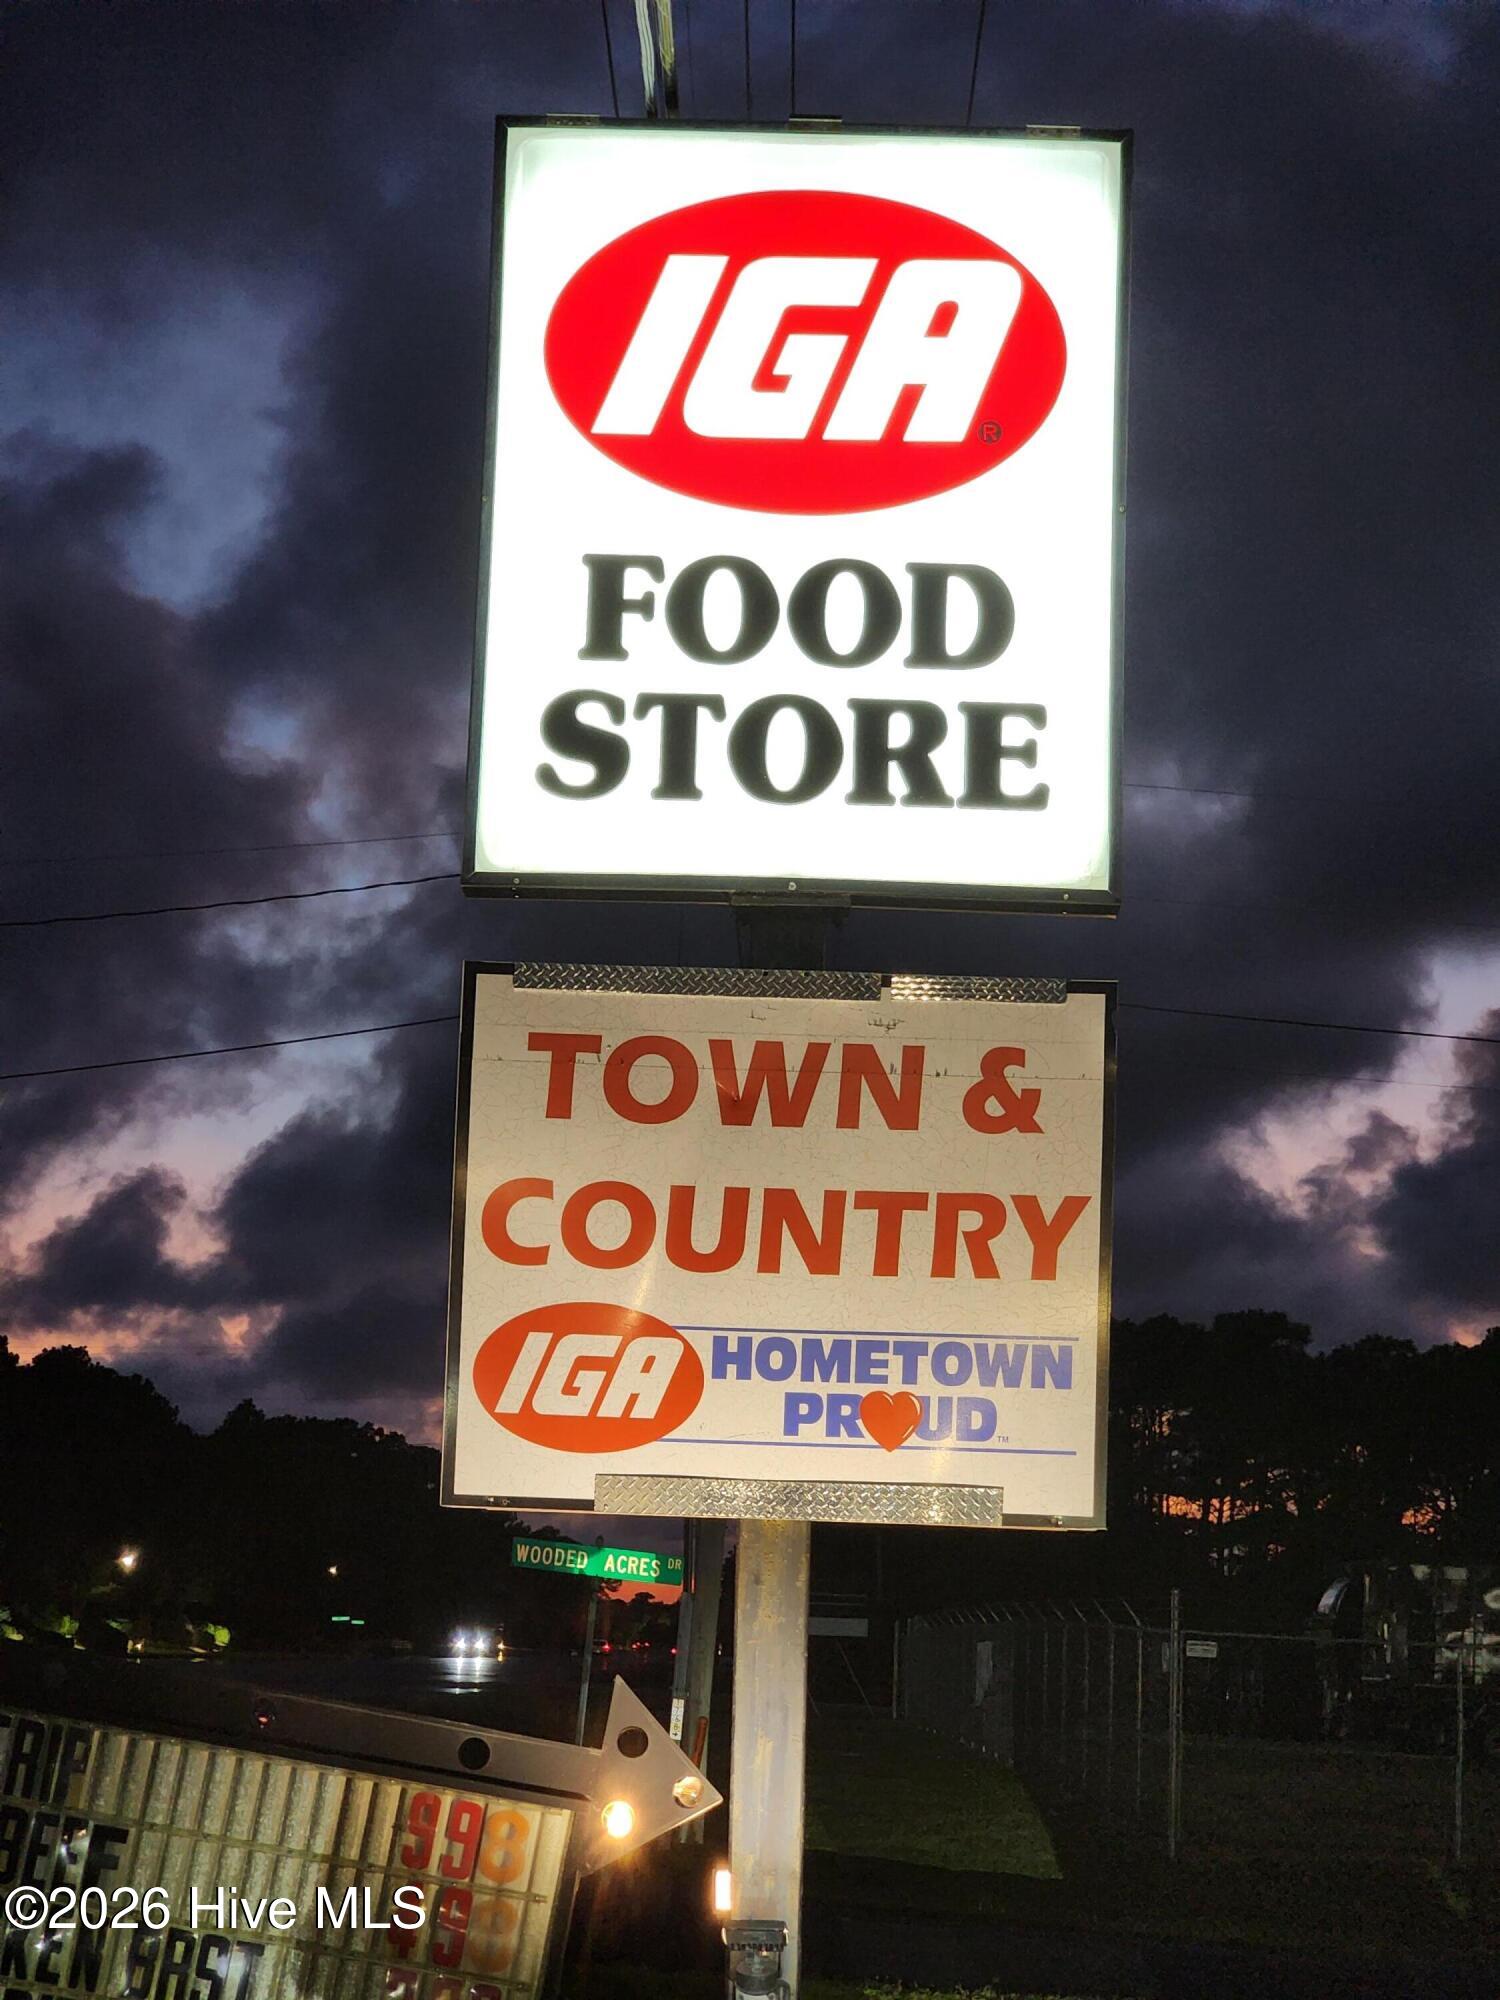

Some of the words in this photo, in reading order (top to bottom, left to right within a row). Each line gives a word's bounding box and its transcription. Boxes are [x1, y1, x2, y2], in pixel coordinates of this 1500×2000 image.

[590, 253, 1023, 442] IGA
[578, 553, 1015, 670] FOOD
[534, 688, 1050, 811] STORE
[528, 1031, 926, 1131] TOWN
[962, 1046, 1044, 1134] &
[481, 1177, 1093, 1281] COUNTRY
[494, 1331, 684, 1420] IGA
[711, 1335, 1074, 1391] HOMETOWN
[783, 1391, 997, 1443] PRUD
[516, 1543, 588, 1569] WOODED
[603, 1554, 661, 1578] ACRES
[667, 1557, 682, 1571] DR
